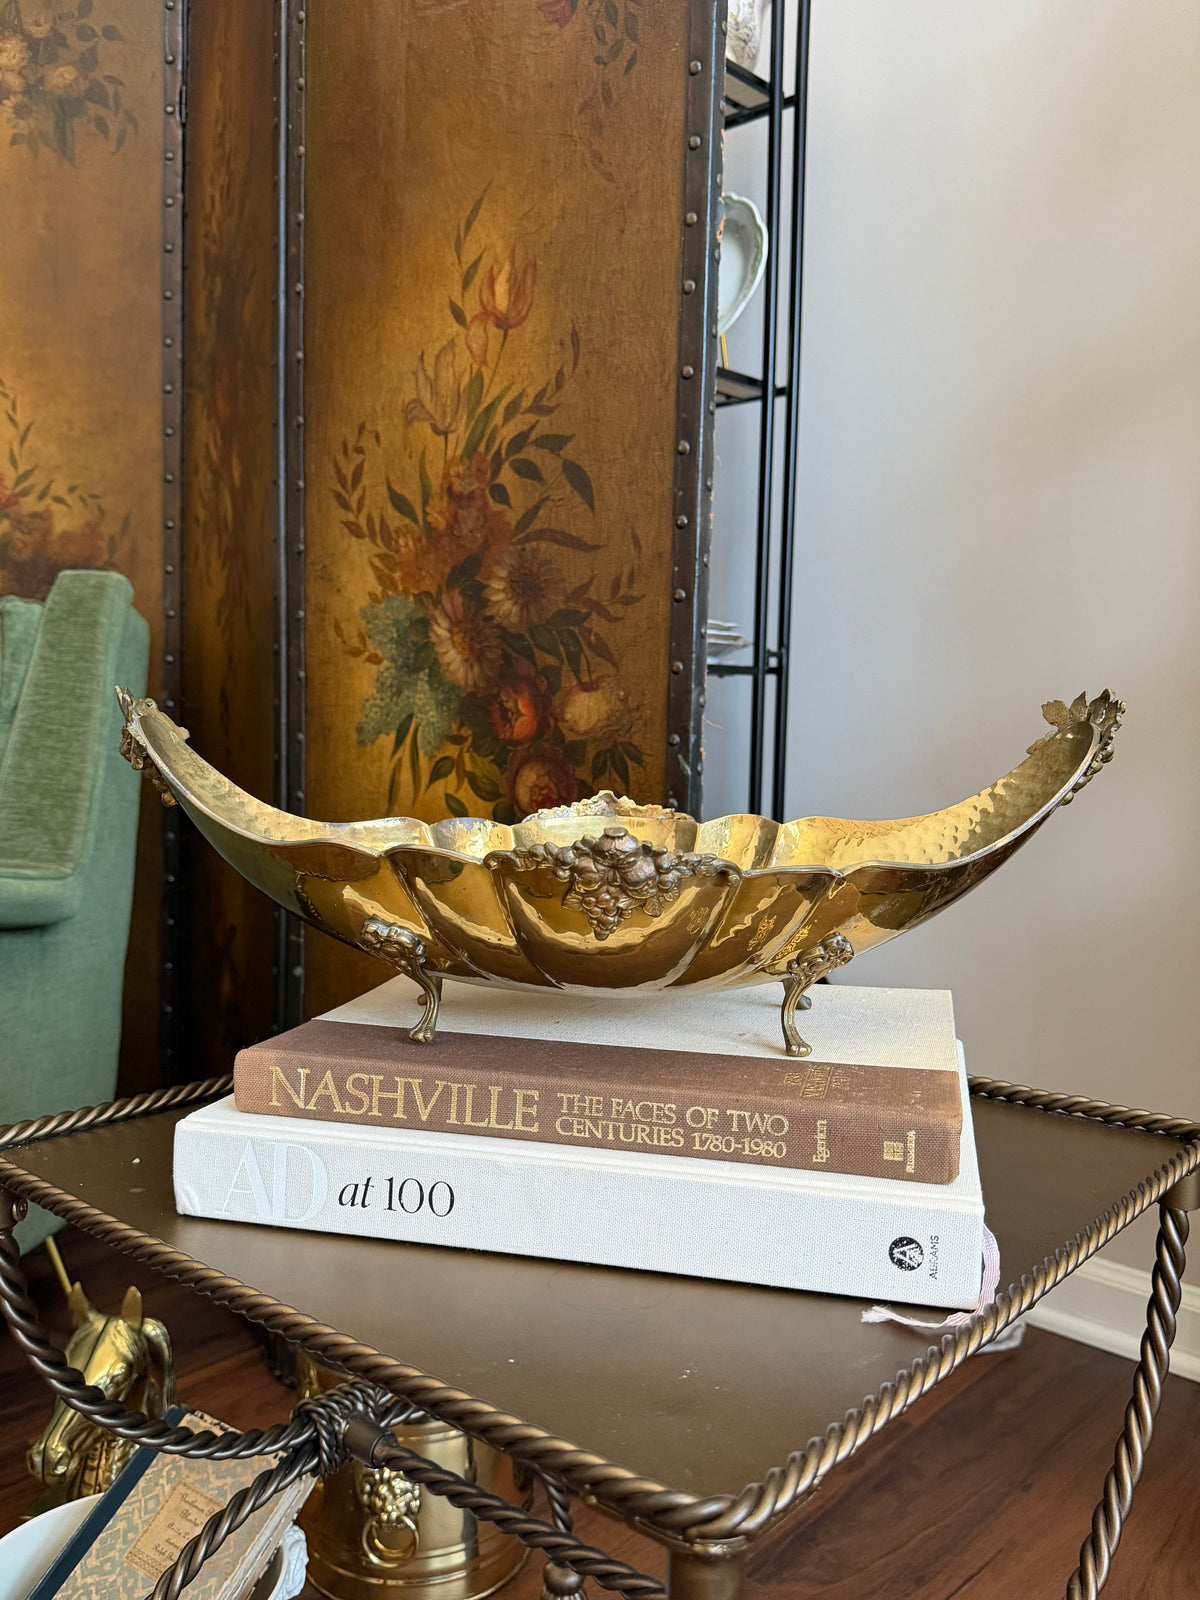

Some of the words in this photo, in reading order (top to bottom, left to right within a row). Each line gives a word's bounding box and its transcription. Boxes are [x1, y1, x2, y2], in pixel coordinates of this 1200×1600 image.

[269, 1066, 540, 1132] NASHVILLE
[557, 1092, 604, 1117] THE
[611, 1097, 677, 1125] FACES
[685, 1105, 720, 1130] OF
[727, 1109, 790, 1137] TWO
[555, 1116, 685, 1149] CENTURIES
[691, 1131, 787, 1159] 1780-1980
[217, 1138, 329, 1222] AD
[337, 1176, 375, 1208] at
[384, 1176, 456, 1218] 100
[929, 1235, 940, 1280] ABRAMS
